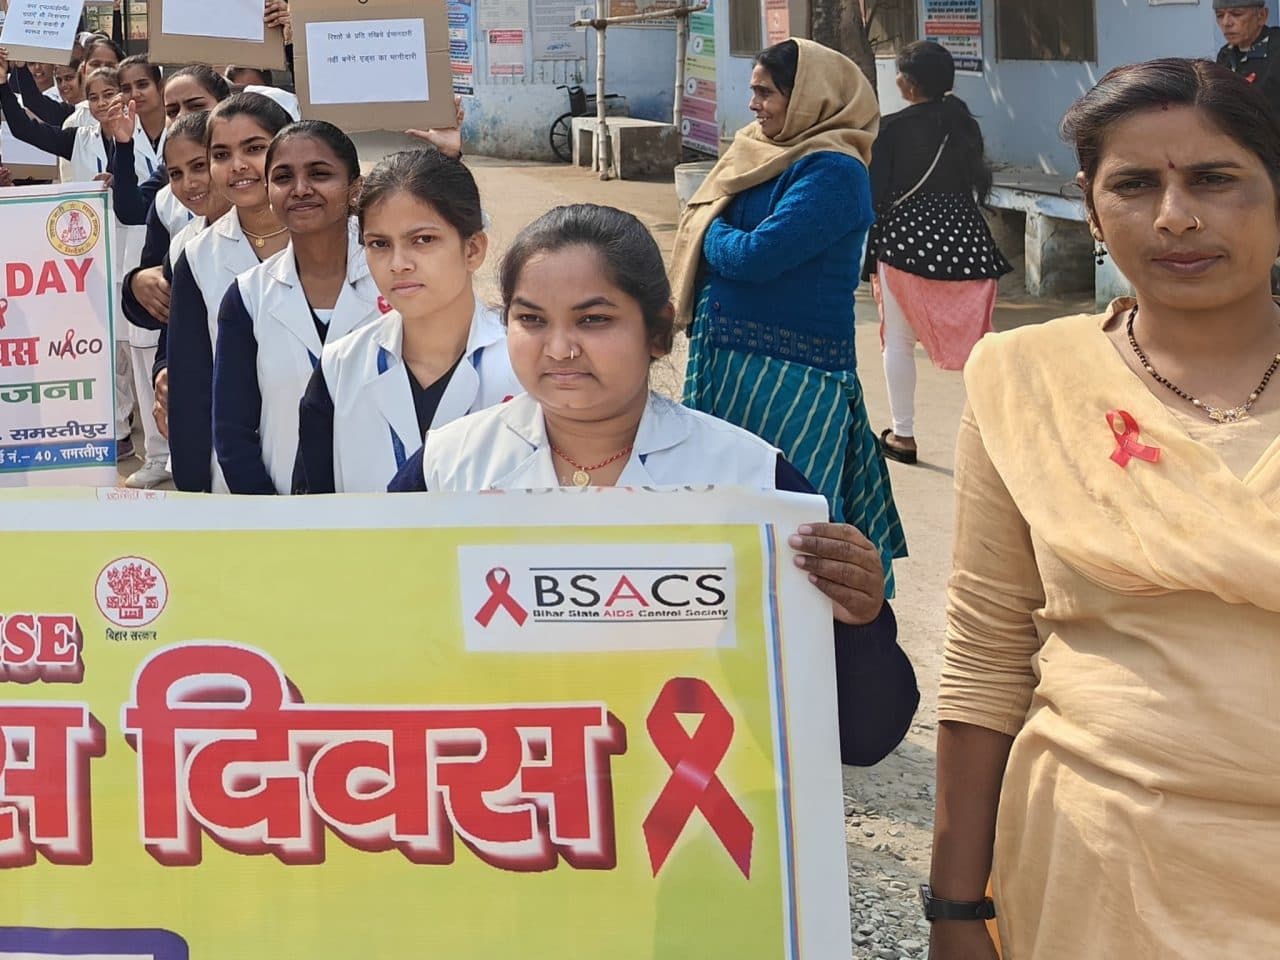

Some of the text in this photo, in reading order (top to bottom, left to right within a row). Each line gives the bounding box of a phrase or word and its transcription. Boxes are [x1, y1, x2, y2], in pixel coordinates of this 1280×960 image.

[5, 257, 94, 298] DAY
[48, 333, 103, 359] NACO
[10, 420, 109, 441] समस्तीपुर
[533, 573, 726, 608] BSACS
[533, 608, 729, 618] Bihar State AIDS Control Society
[130, 629, 158, 642] सरकार
[121, 641, 627, 873] दिवस
